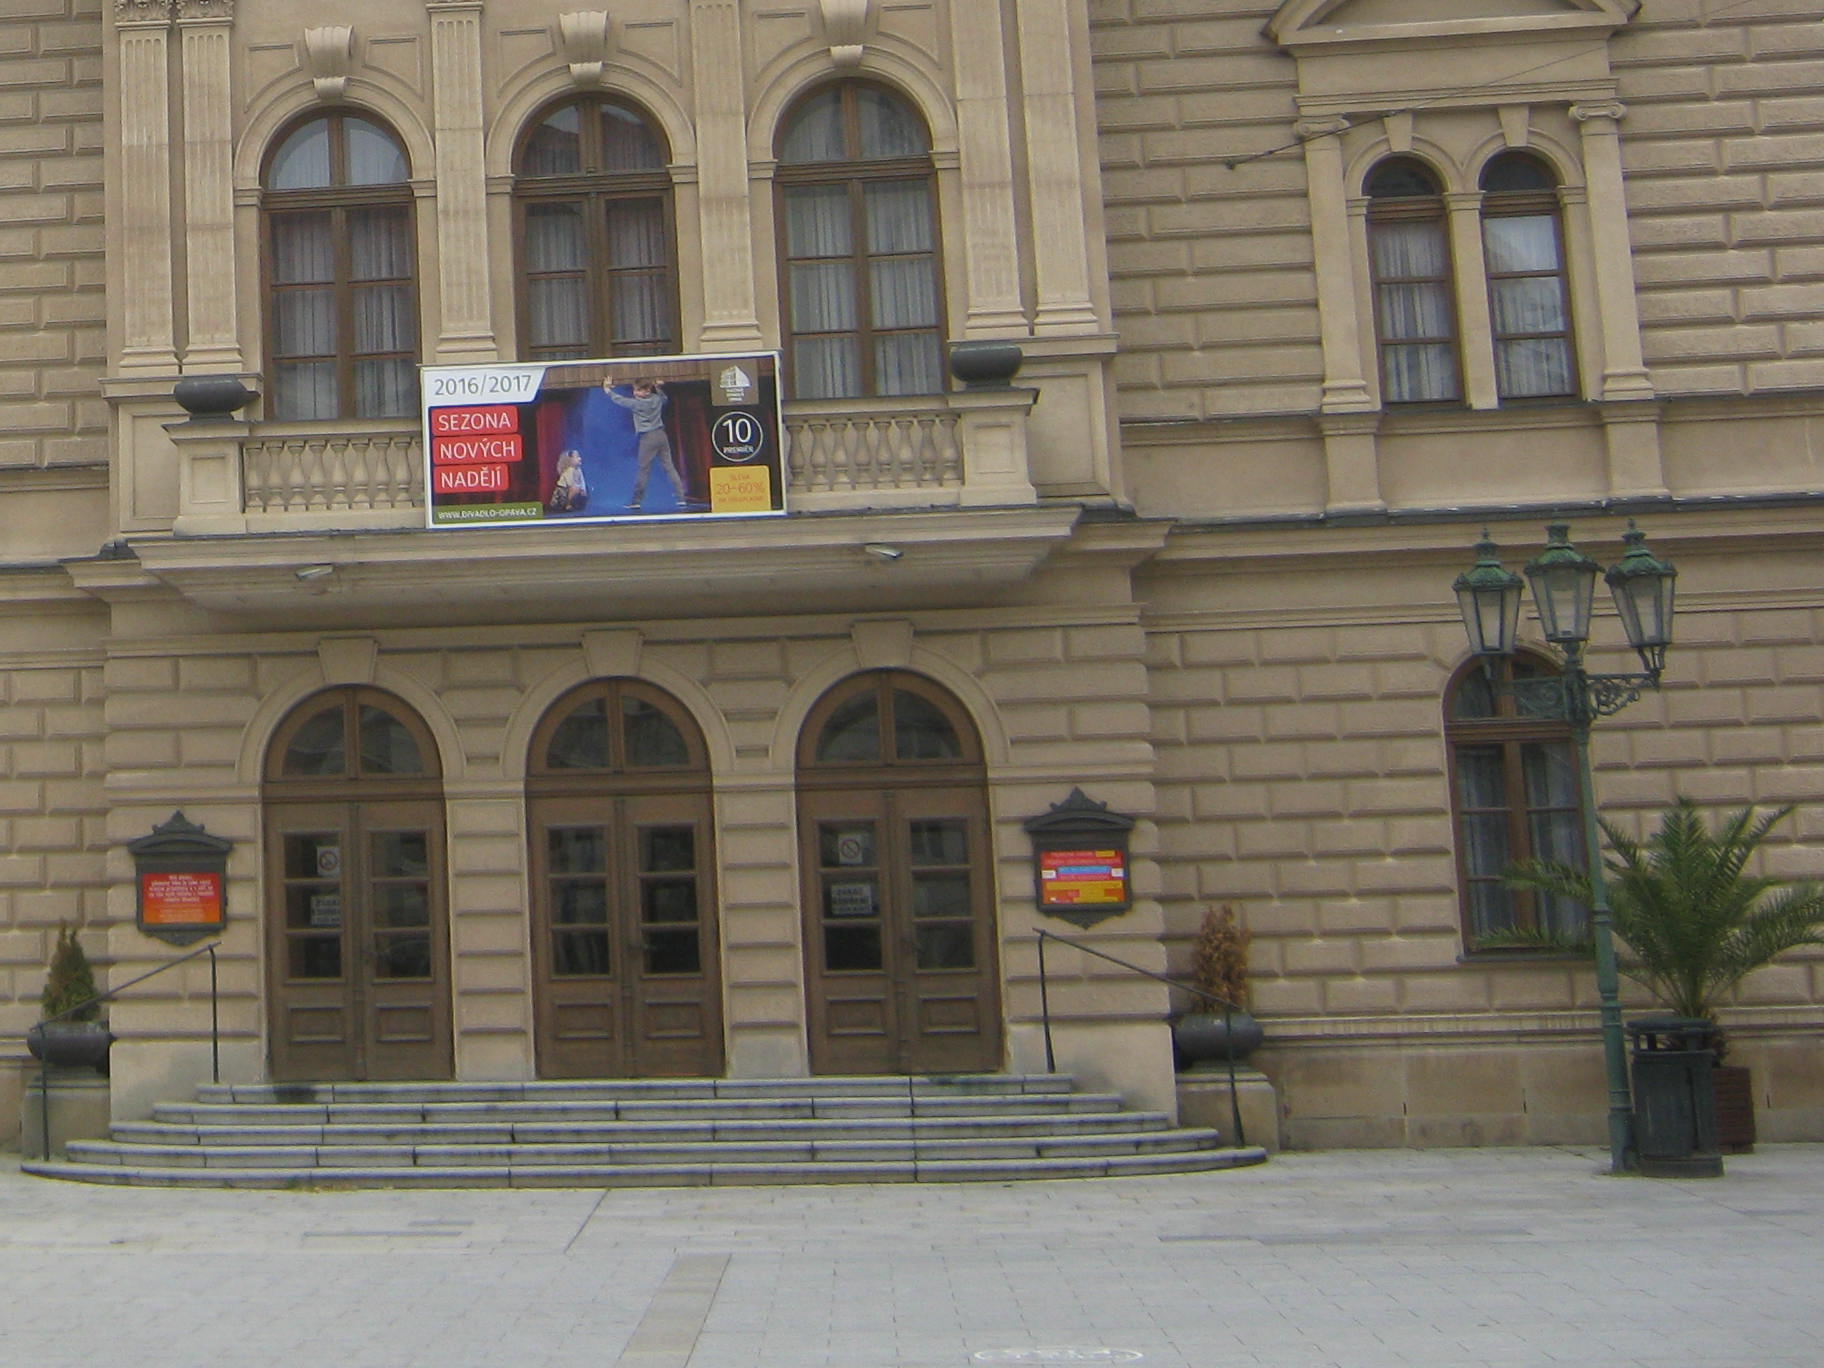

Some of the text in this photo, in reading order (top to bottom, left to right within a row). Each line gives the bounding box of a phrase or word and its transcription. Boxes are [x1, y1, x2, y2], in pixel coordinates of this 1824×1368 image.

[434, 374, 532, 397] 2016/2017
[438, 412, 511, 432] SEZONA
[722, 418, 752, 444] 10
[440, 438, 515, 459] NOVÝCH
[441, 466, 502, 489] NADĚJÍ
